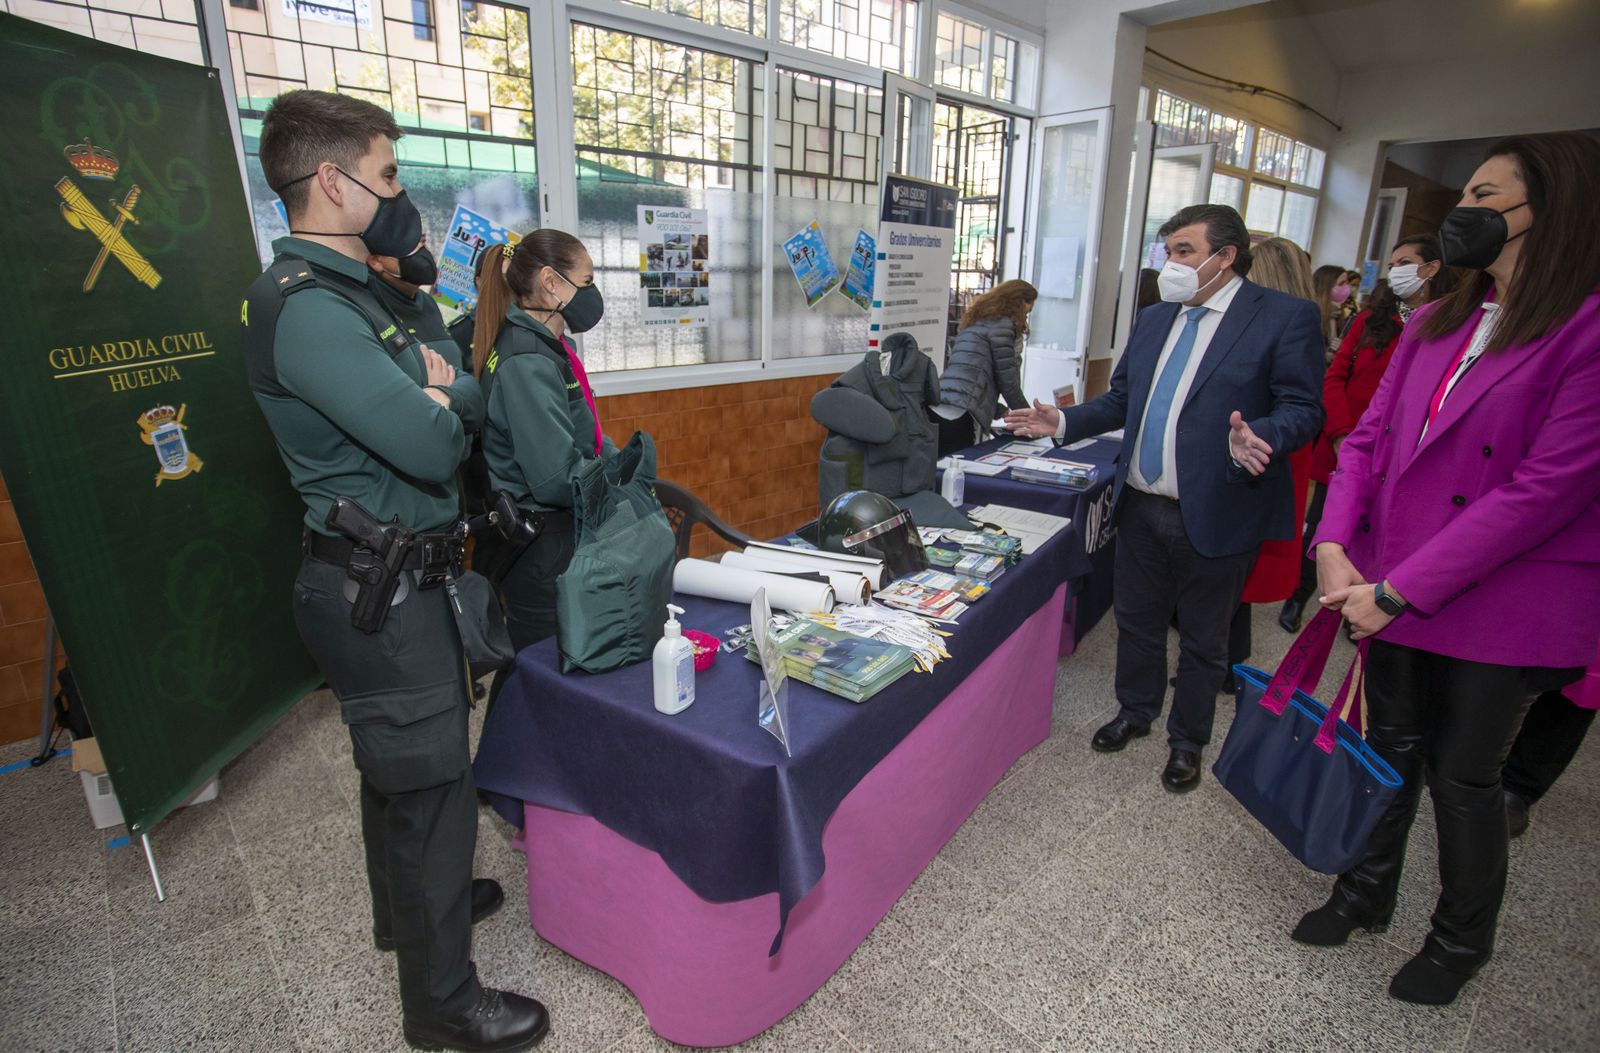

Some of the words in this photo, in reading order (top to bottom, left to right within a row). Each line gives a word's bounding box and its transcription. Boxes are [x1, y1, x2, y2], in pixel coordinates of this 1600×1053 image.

[656, 210, 679, 218] Guardia
[679, 211, 692, 219] Civil
[889, 231, 908, 247] Grados
[908, 233, 942, 248] Universitarios
[49, 338, 160, 370] GUARDIA
[161, 331, 213, 354] CIVIL
[108, 365, 181, 392] HUELVA
